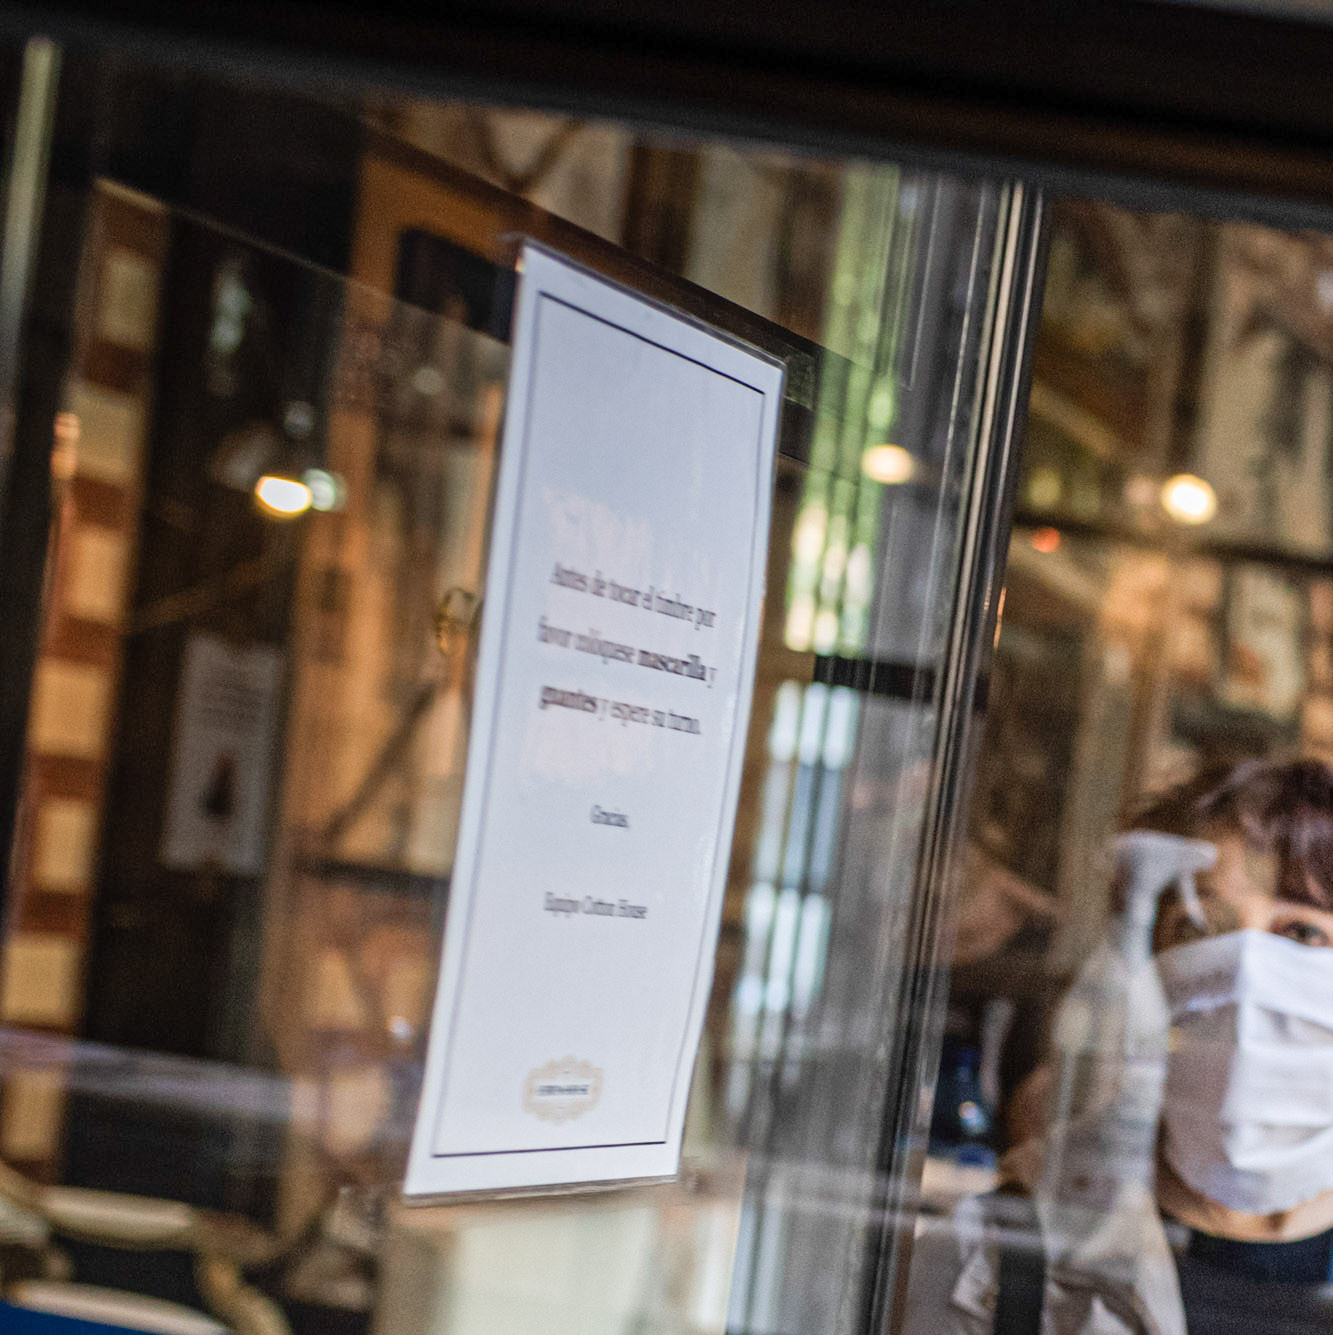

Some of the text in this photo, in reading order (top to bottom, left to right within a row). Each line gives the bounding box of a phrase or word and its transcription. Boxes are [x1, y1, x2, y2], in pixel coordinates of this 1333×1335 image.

[590, 569, 607, 599] de
[608, 579, 641, 608] tocar
[642, 585, 654, 612] el
[694, 607, 717, 631] por
[537, 615, 573, 649] favor
[707, 667, 718, 688] y
[598, 698, 609, 721] y
[609, 700, 650, 728] espere
[651, 709, 665, 728] su
